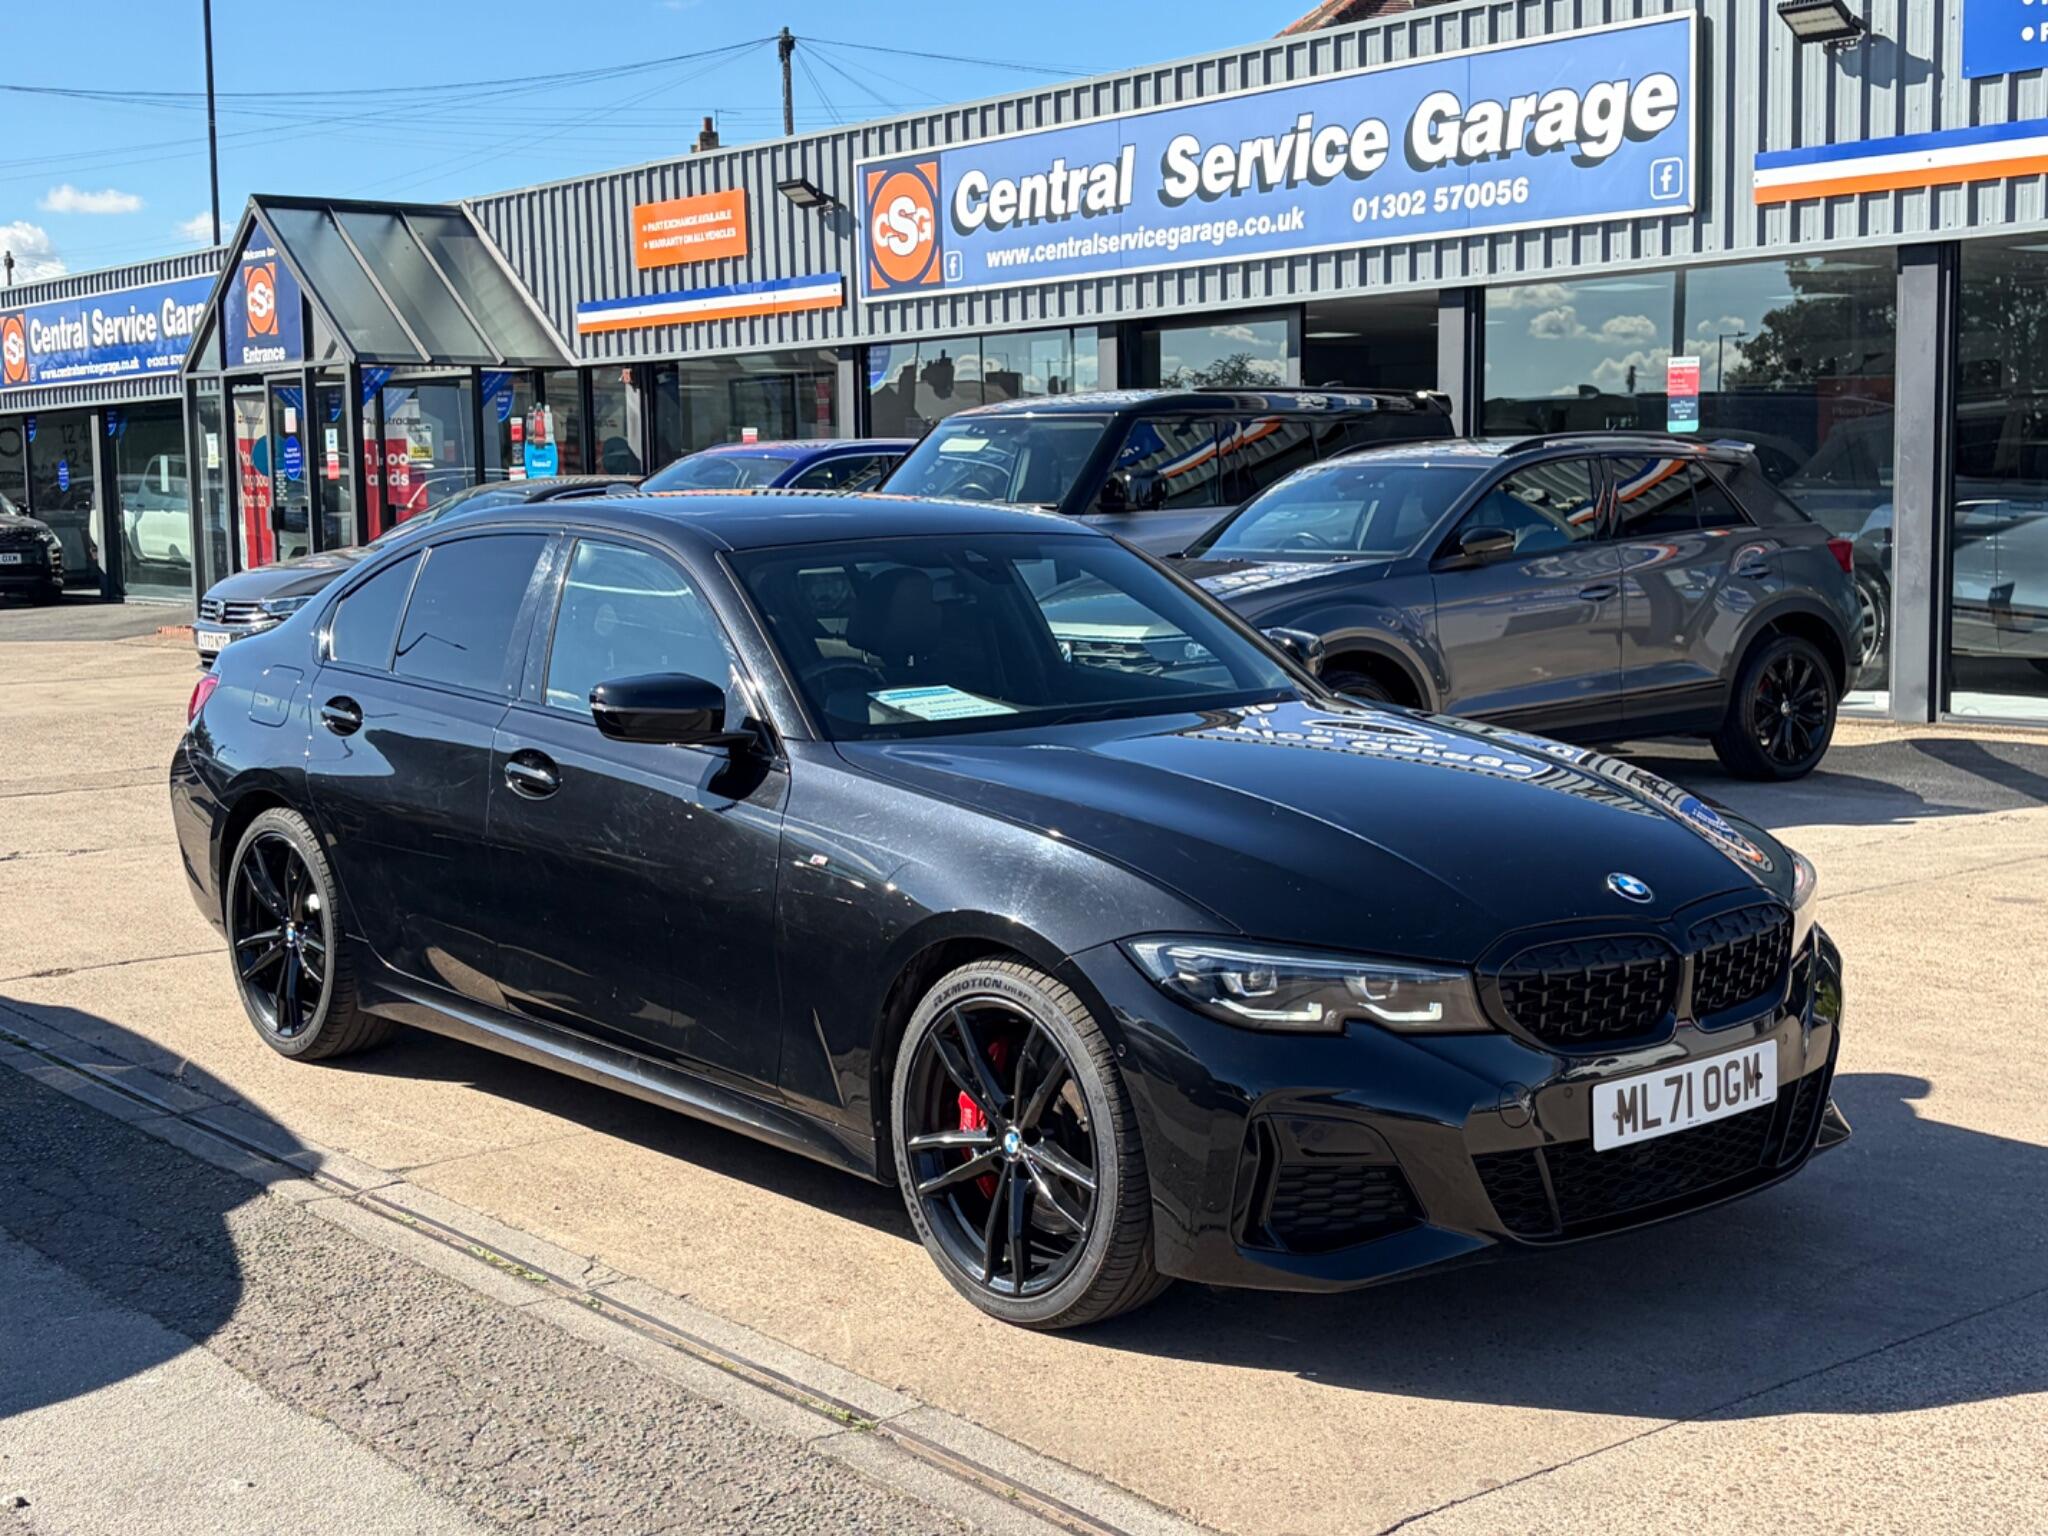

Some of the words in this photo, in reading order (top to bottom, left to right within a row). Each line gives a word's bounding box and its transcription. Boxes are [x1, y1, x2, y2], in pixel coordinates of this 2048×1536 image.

[953, 144, 1136, 231] Central
[1160, 112, 1390, 202] Service
[1409, 72, 1680, 166] Garage
[874, 195, 932, 257] CSG
[986, 206, 1304, 269] www.centralservicegarage.co.uk
[1352, 191, 1426, 222] 01302
[1432, 177, 1529, 211] 570056
[30, 311, 88, 353] Central
[92, 305, 157, 346] Service
[162, 297, 208, 338] Gara
[243, 346, 286, 363] Entrance
[1616, 1072, 1695, 1137] ML71
[1703, 1051, 1762, 1113] OGM
